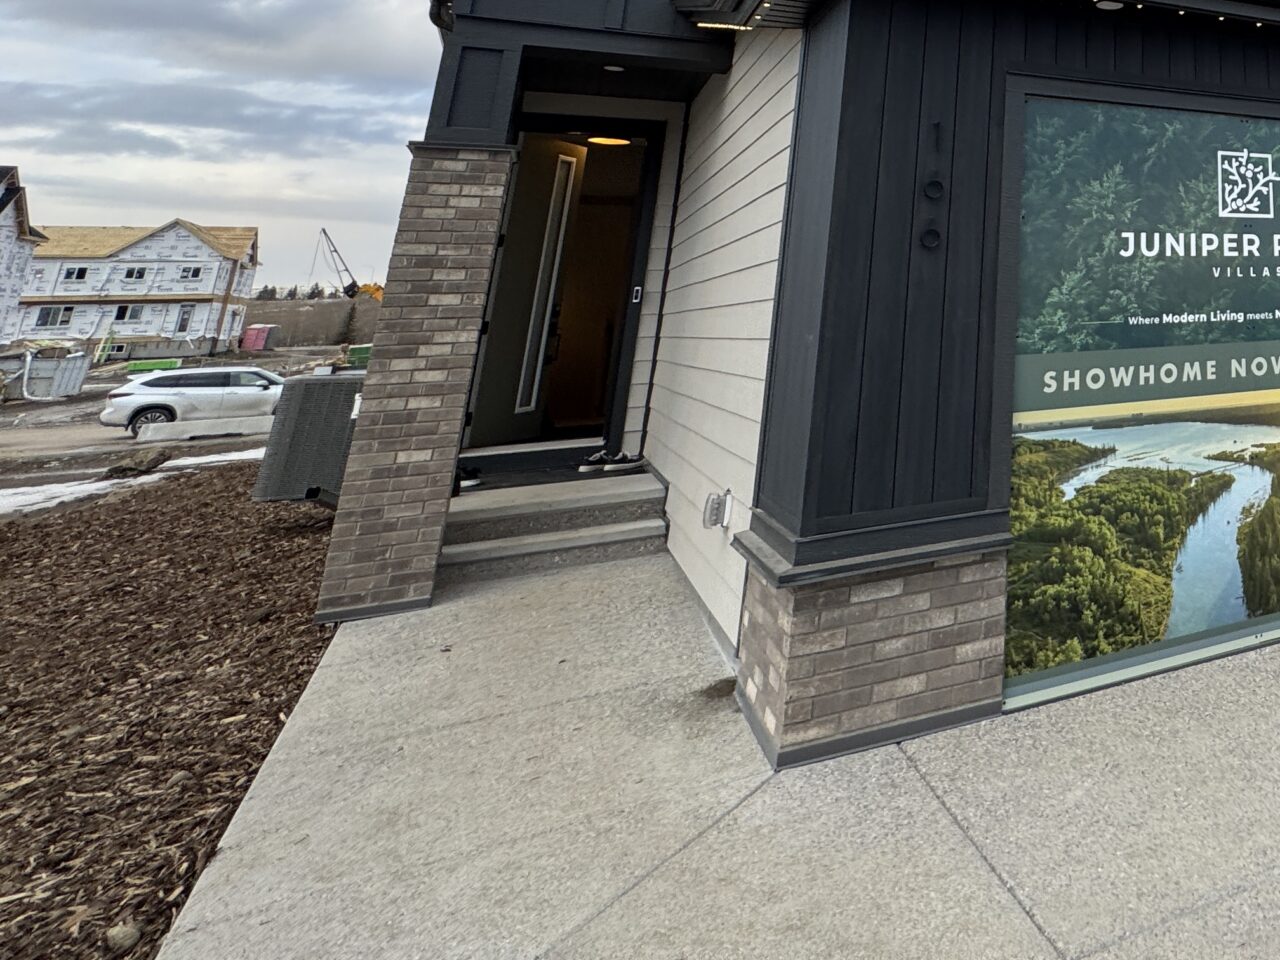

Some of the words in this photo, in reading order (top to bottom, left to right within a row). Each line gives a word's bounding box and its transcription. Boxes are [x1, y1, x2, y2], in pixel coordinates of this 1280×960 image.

[1119, 232, 1260, 257] JUNIPER
[1128, 316, 1160, 325] Where
[1162, 312, 1207, 324] Modern
[1210, 310, 1245, 323] Living
[1246, 312, 1273, 320] meets
[1043, 360, 1217, 393] SHOWHOME
